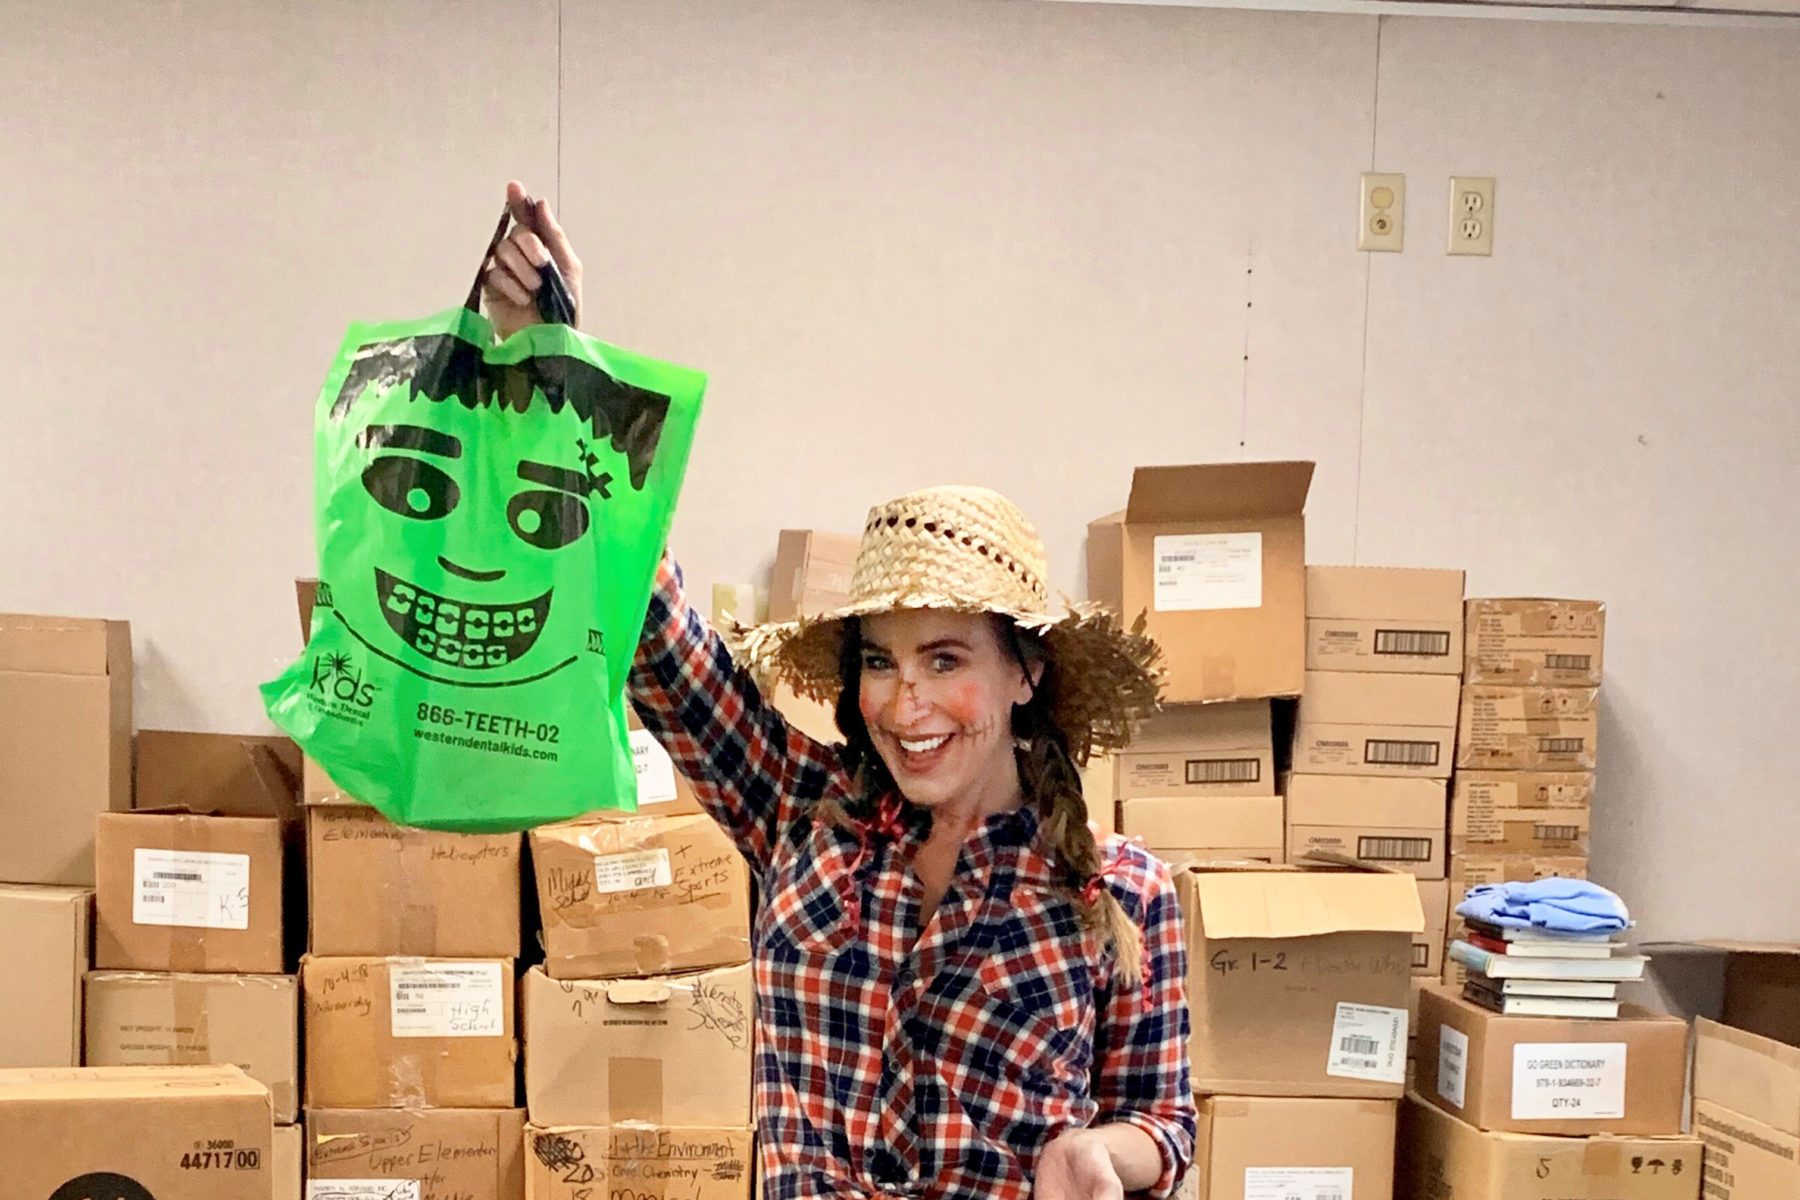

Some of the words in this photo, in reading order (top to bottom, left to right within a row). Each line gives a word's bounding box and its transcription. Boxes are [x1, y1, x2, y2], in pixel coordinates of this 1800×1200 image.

[416, 702, 560, 744] 866-TEETH-02
[413, 727, 559, 762] westerndentalkids.com
[674, 854, 733, 885] Extreme
[676, 870, 729, 903] Sports
[1251, 951, 1289, 972] 1-2
[1526, 1060, 1538, 1069] GO
[1539, 1060, 1563, 1069] GREEN
[1564, 1060, 1606, 1069] DICTIONARY
[368, 1153, 414, 1174] Upper
